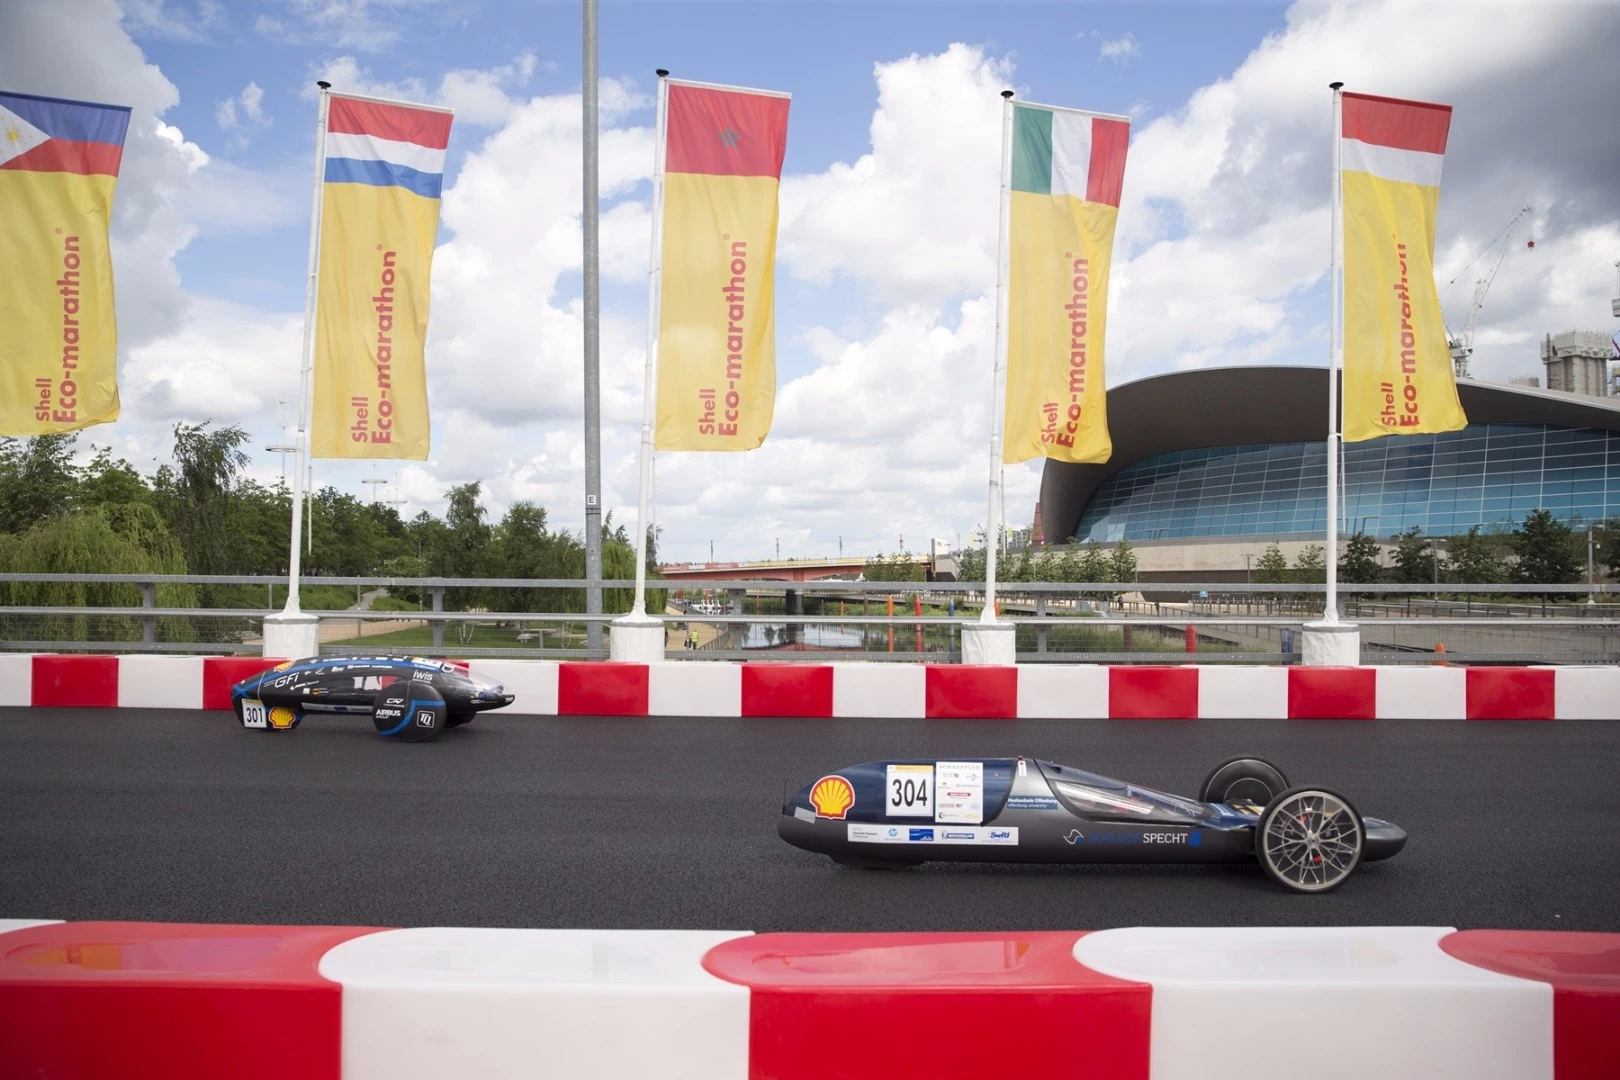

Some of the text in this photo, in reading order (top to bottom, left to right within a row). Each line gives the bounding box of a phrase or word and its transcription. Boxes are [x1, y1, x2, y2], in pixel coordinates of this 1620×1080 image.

[53, 236, 80, 422] Eco-marathon
[371, 251, 397, 444] Eco-marathon
[718, 241, 747, 436] Eco-marathon
[1056, 258, 1088, 448] Eco-marathon
[35, 378, 52, 421] Shell
[352, 396, 368, 443] Shell
[698, 388, 715, 435] Shell
[1381, 382, 1397, 426] Shell
[1041, 402, 1058, 444] Shell
[413, 669, 433, 681] iwis
[246, 707, 263, 723] 301
[376, 709, 401, 717] AIRBUS
[420, 713, 431, 726] TQ
[891, 779, 927, 807] 304
